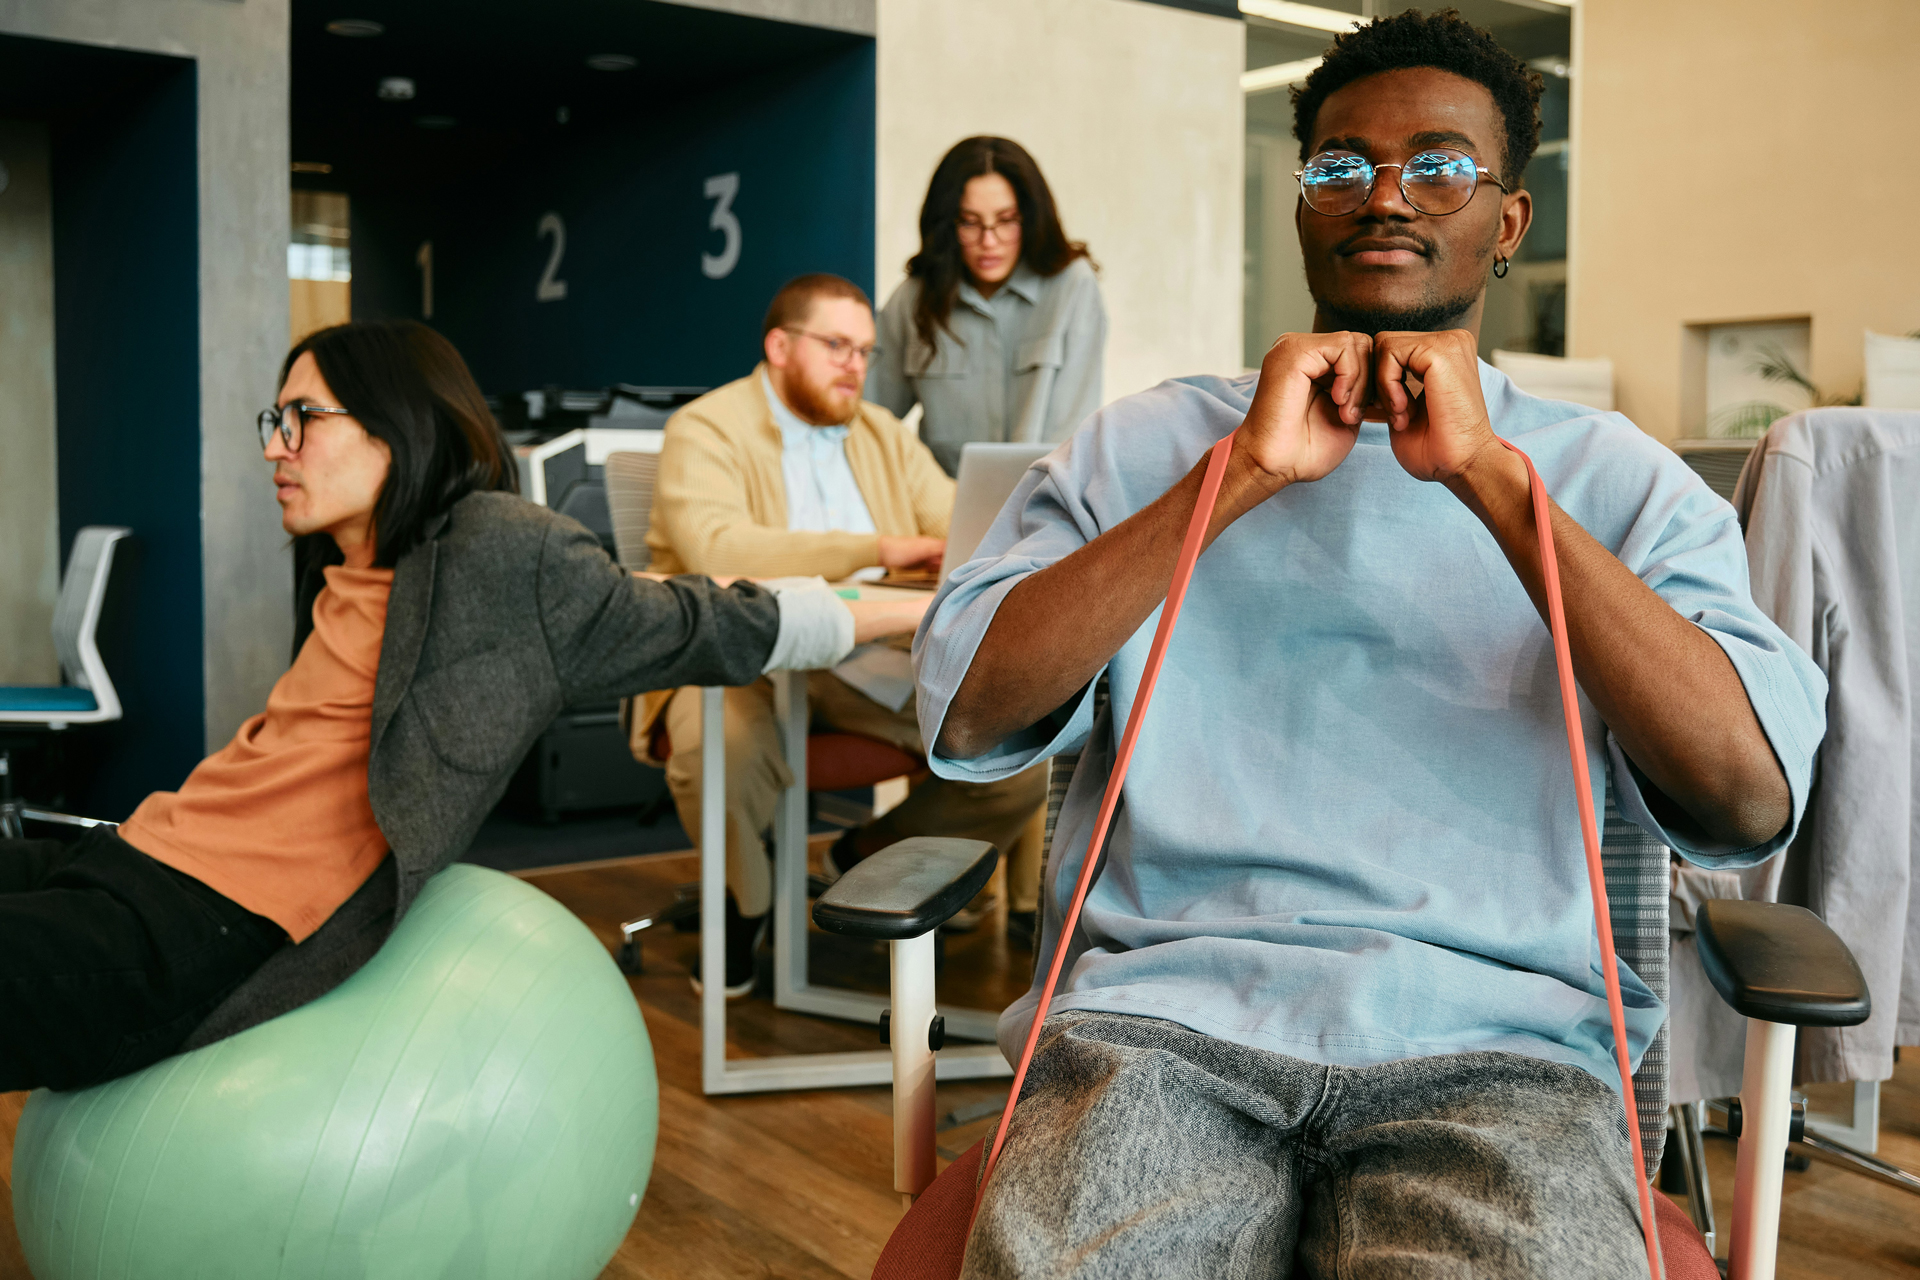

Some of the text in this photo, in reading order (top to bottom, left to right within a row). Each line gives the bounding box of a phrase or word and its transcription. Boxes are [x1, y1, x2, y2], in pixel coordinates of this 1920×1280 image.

[537, 214, 567, 301] 2
[702, 173, 741, 278] 3
[417, 242, 433, 318] 1
